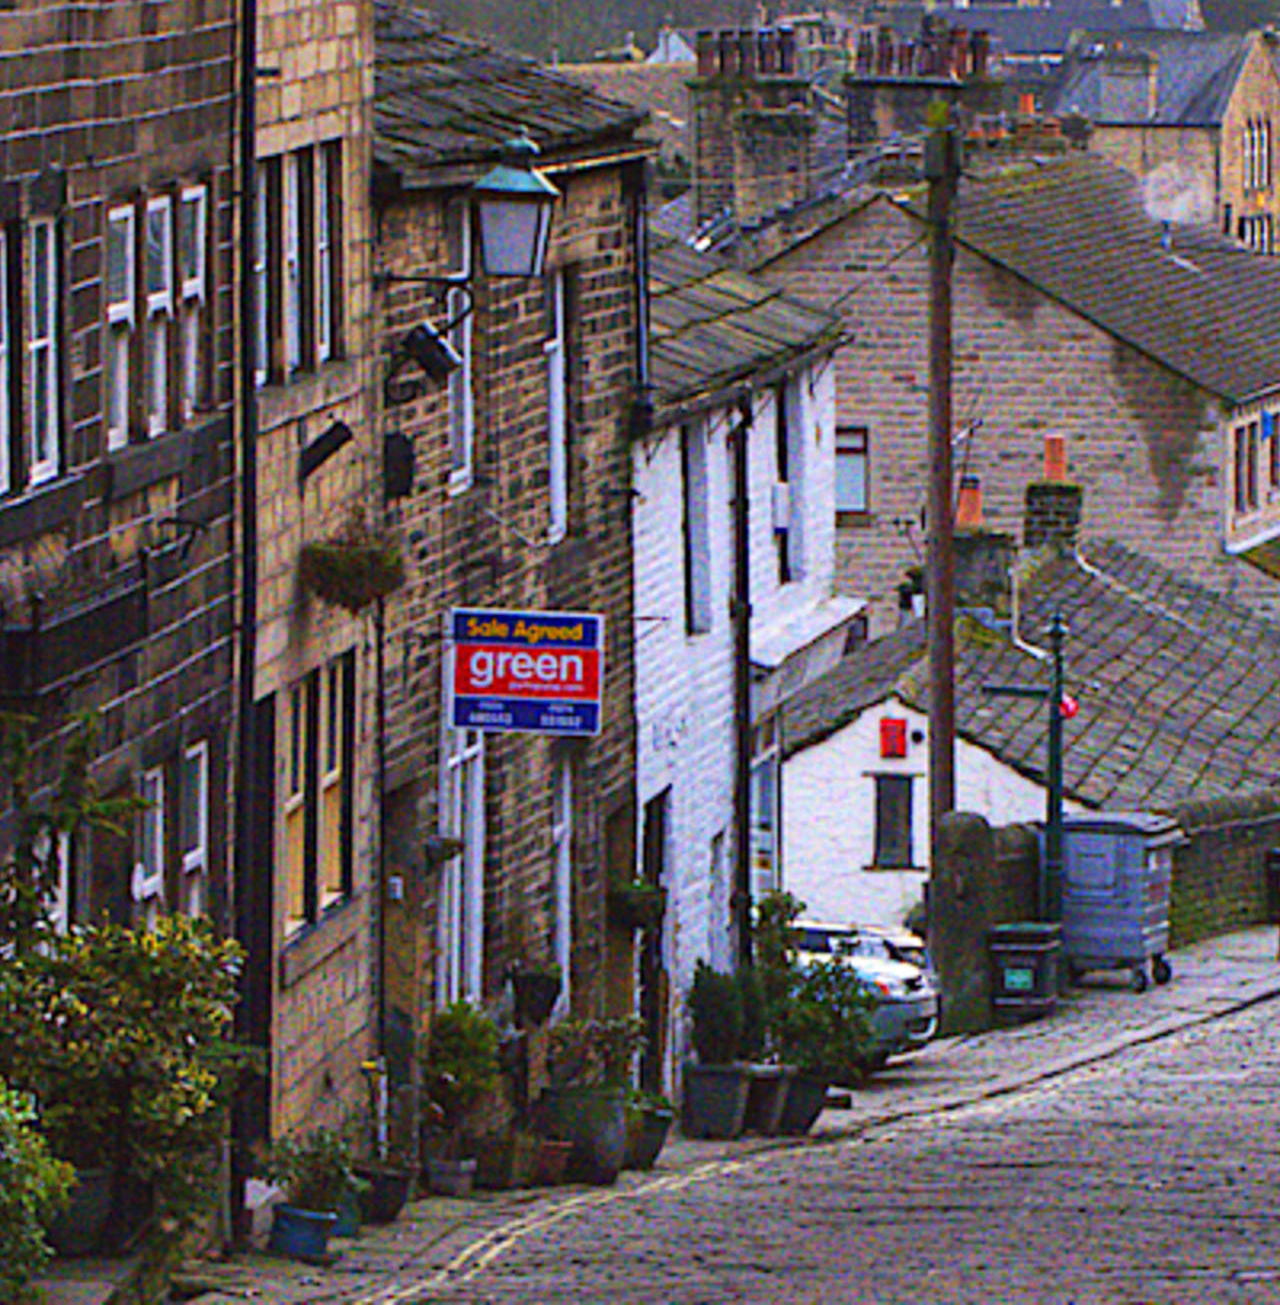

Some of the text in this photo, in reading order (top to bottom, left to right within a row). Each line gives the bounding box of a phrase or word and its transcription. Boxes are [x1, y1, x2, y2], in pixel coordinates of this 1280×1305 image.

[467, 617, 584, 643] Sale Agreed
[470, 650, 583, 689] green
